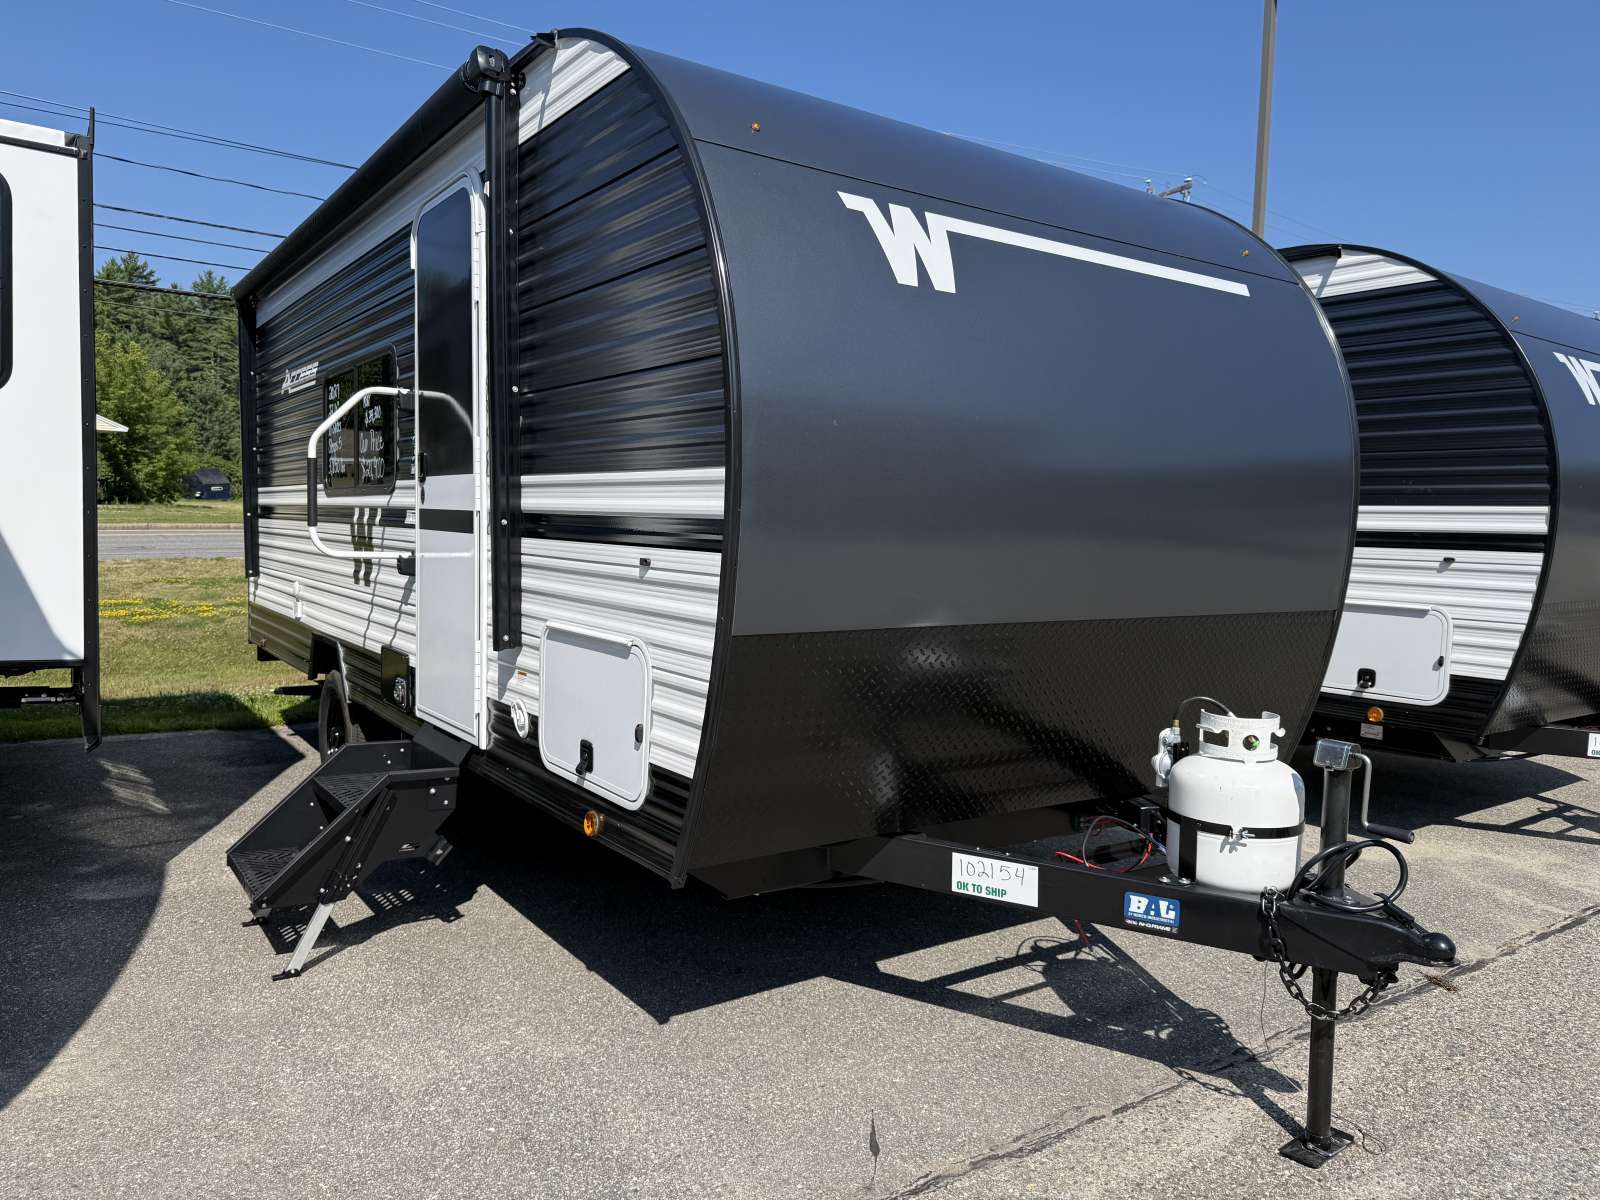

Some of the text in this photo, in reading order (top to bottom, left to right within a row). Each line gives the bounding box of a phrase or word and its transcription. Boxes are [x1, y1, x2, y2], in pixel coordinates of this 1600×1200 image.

[959, 858, 1025, 886] 102154
[956, 880, 1007, 898] OK TO SHIP
[1128, 894, 1176, 920] BAL
